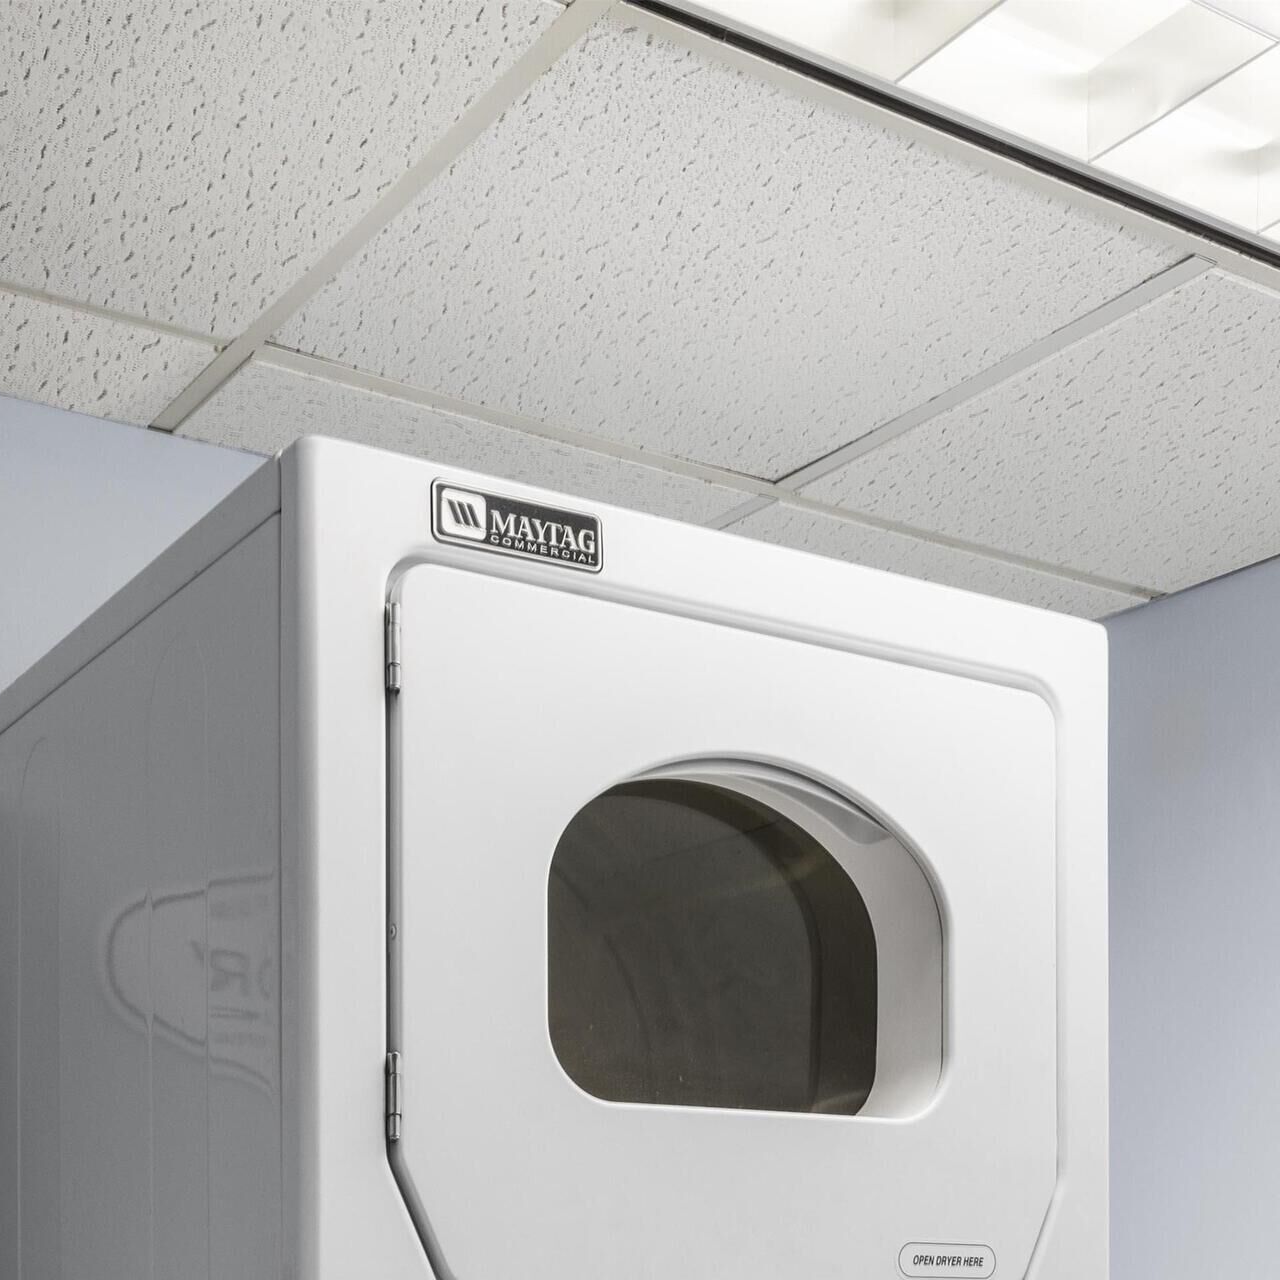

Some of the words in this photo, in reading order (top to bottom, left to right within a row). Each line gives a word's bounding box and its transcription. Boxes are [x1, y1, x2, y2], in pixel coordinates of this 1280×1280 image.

[490, 509, 595, 554] MAYTAG
[489, 535, 596, 564] COMMERCIAL
[912, 1254, 935, 1266] OPEN
[936, 1255, 962, 1267] DRYER
[963, 1256, 984, 1267] HERE
